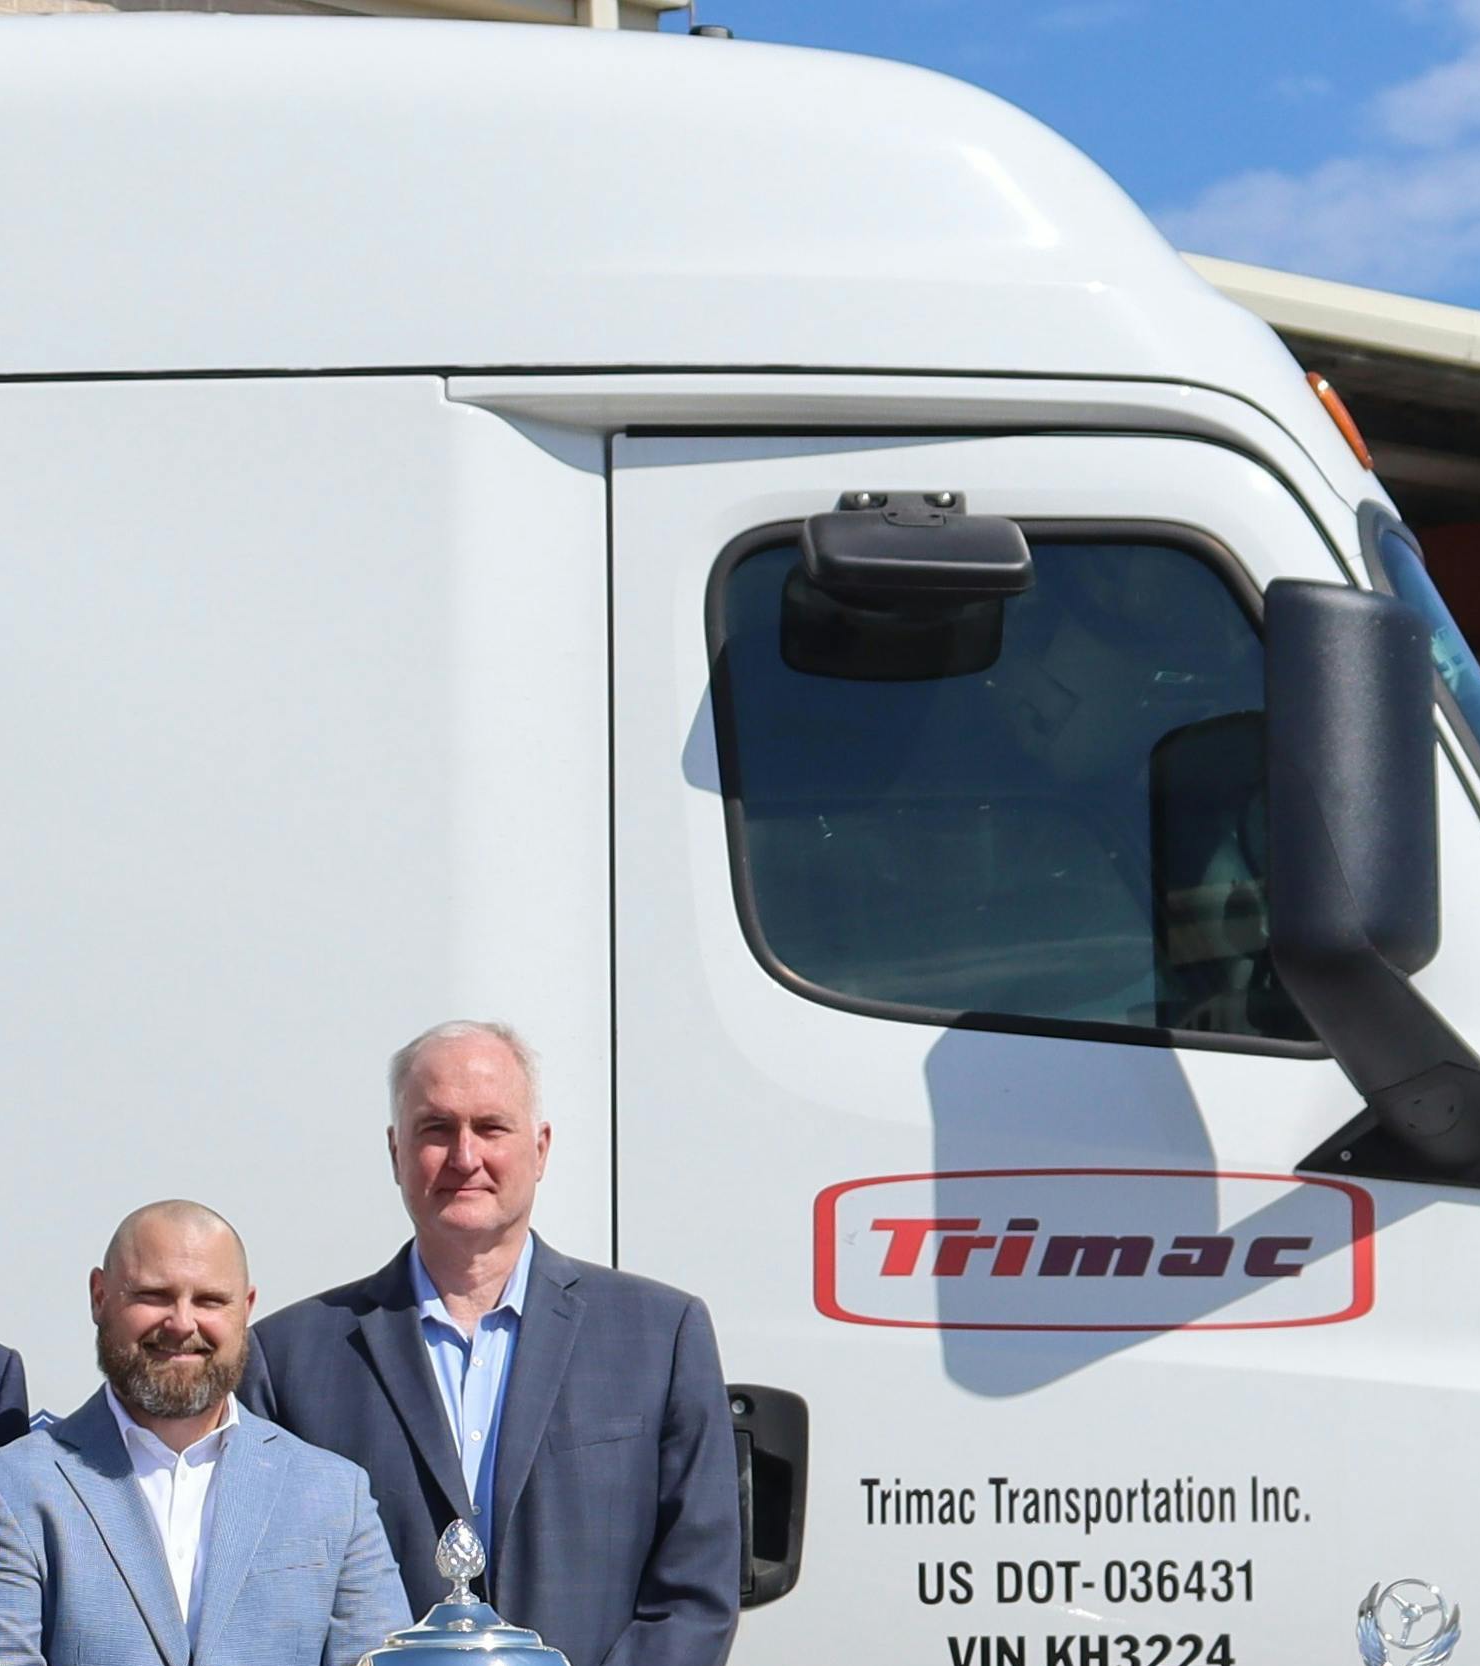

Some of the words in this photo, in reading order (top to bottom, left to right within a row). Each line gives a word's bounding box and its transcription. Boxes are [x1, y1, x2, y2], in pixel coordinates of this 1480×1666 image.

[869, 1217, 1314, 1279] Trimac
[860, 1477, 976, 1528] Trimac
[987, 1477, 1238, 1536] Transportation
[1249, 1475, 1312, 1525] Inc.
[916, 1560, 974, 1606] US
